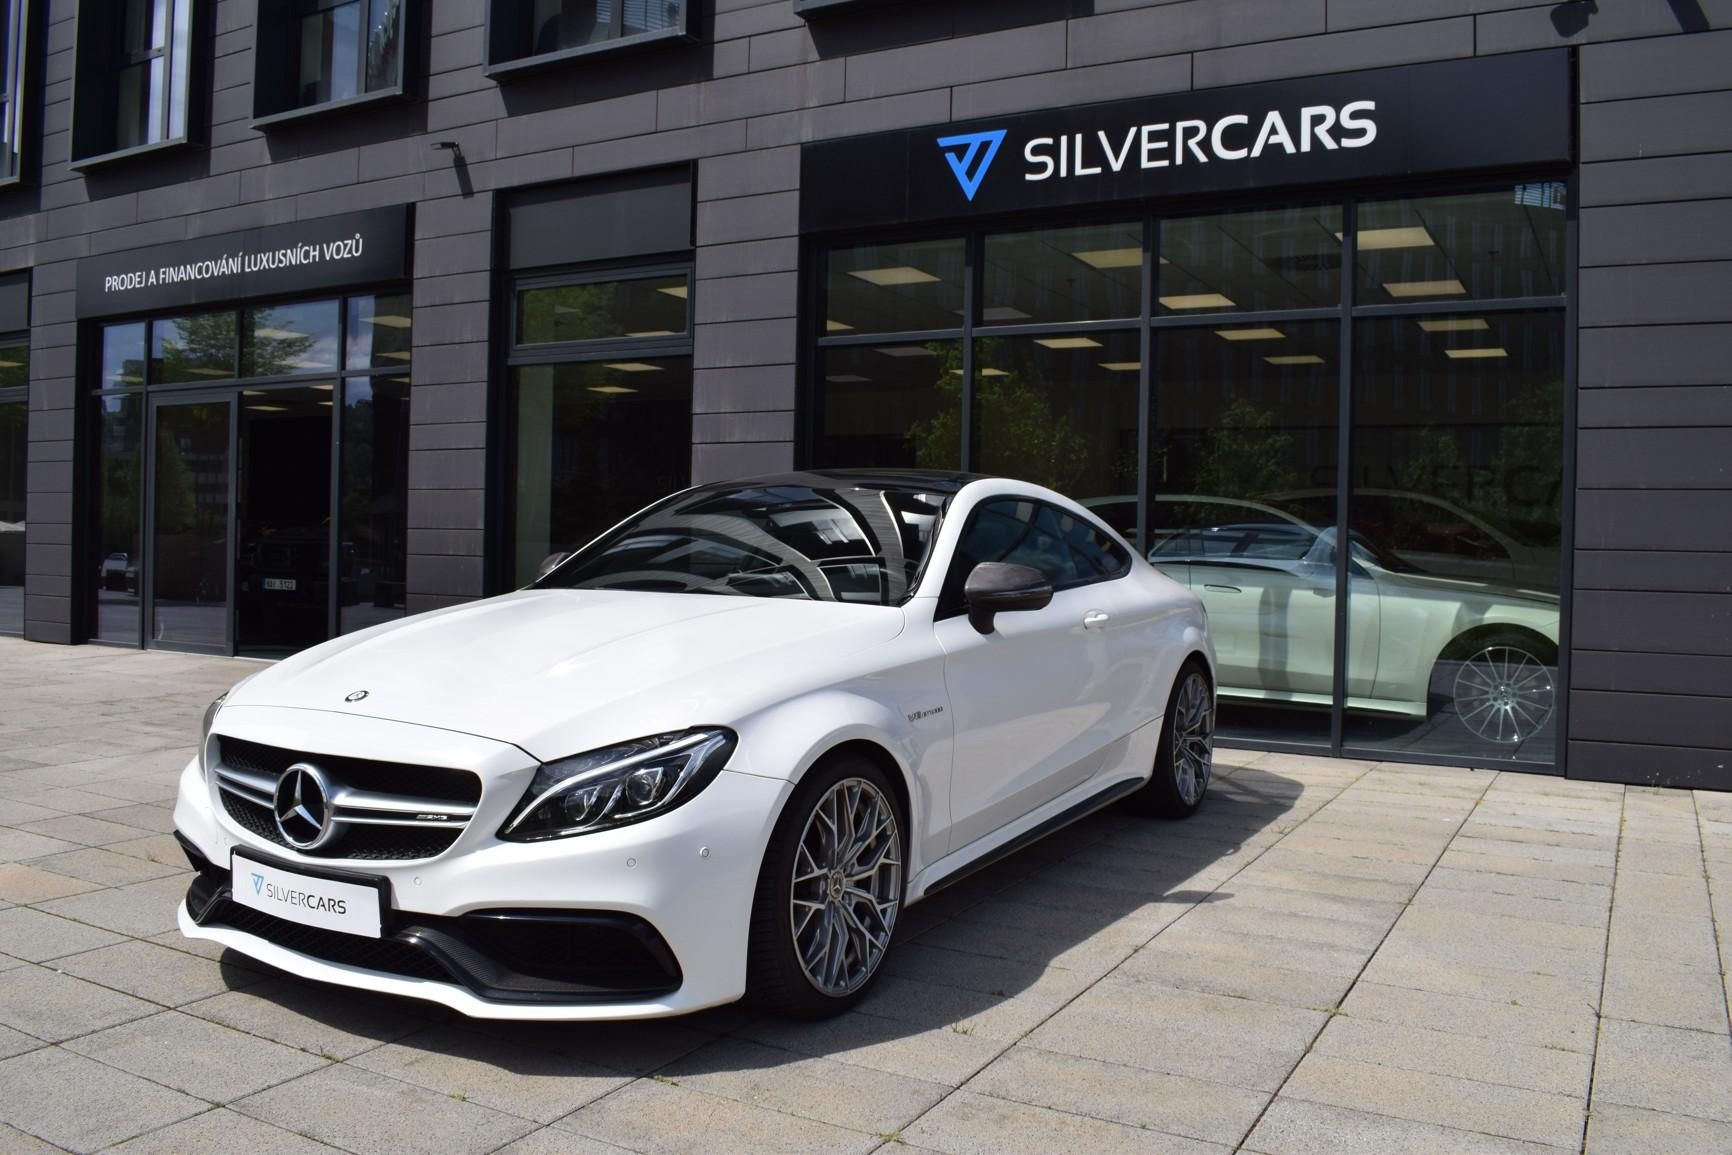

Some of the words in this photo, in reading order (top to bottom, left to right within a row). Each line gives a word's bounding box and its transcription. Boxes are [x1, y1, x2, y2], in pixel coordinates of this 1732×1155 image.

[1025, 101, 1377, 181] SILVERCARS
[105, 271, 145, 292] PRODEJ
[148, 269, 156, 286] A
[159, 253, 242, 285] FINANCOVÁNÍ
[244, 242, 319, 272] LUXUSNÍCH
[323, 233, 362, 260] VOZŮ
[266, 883, 347, 915] SILVERCARS
